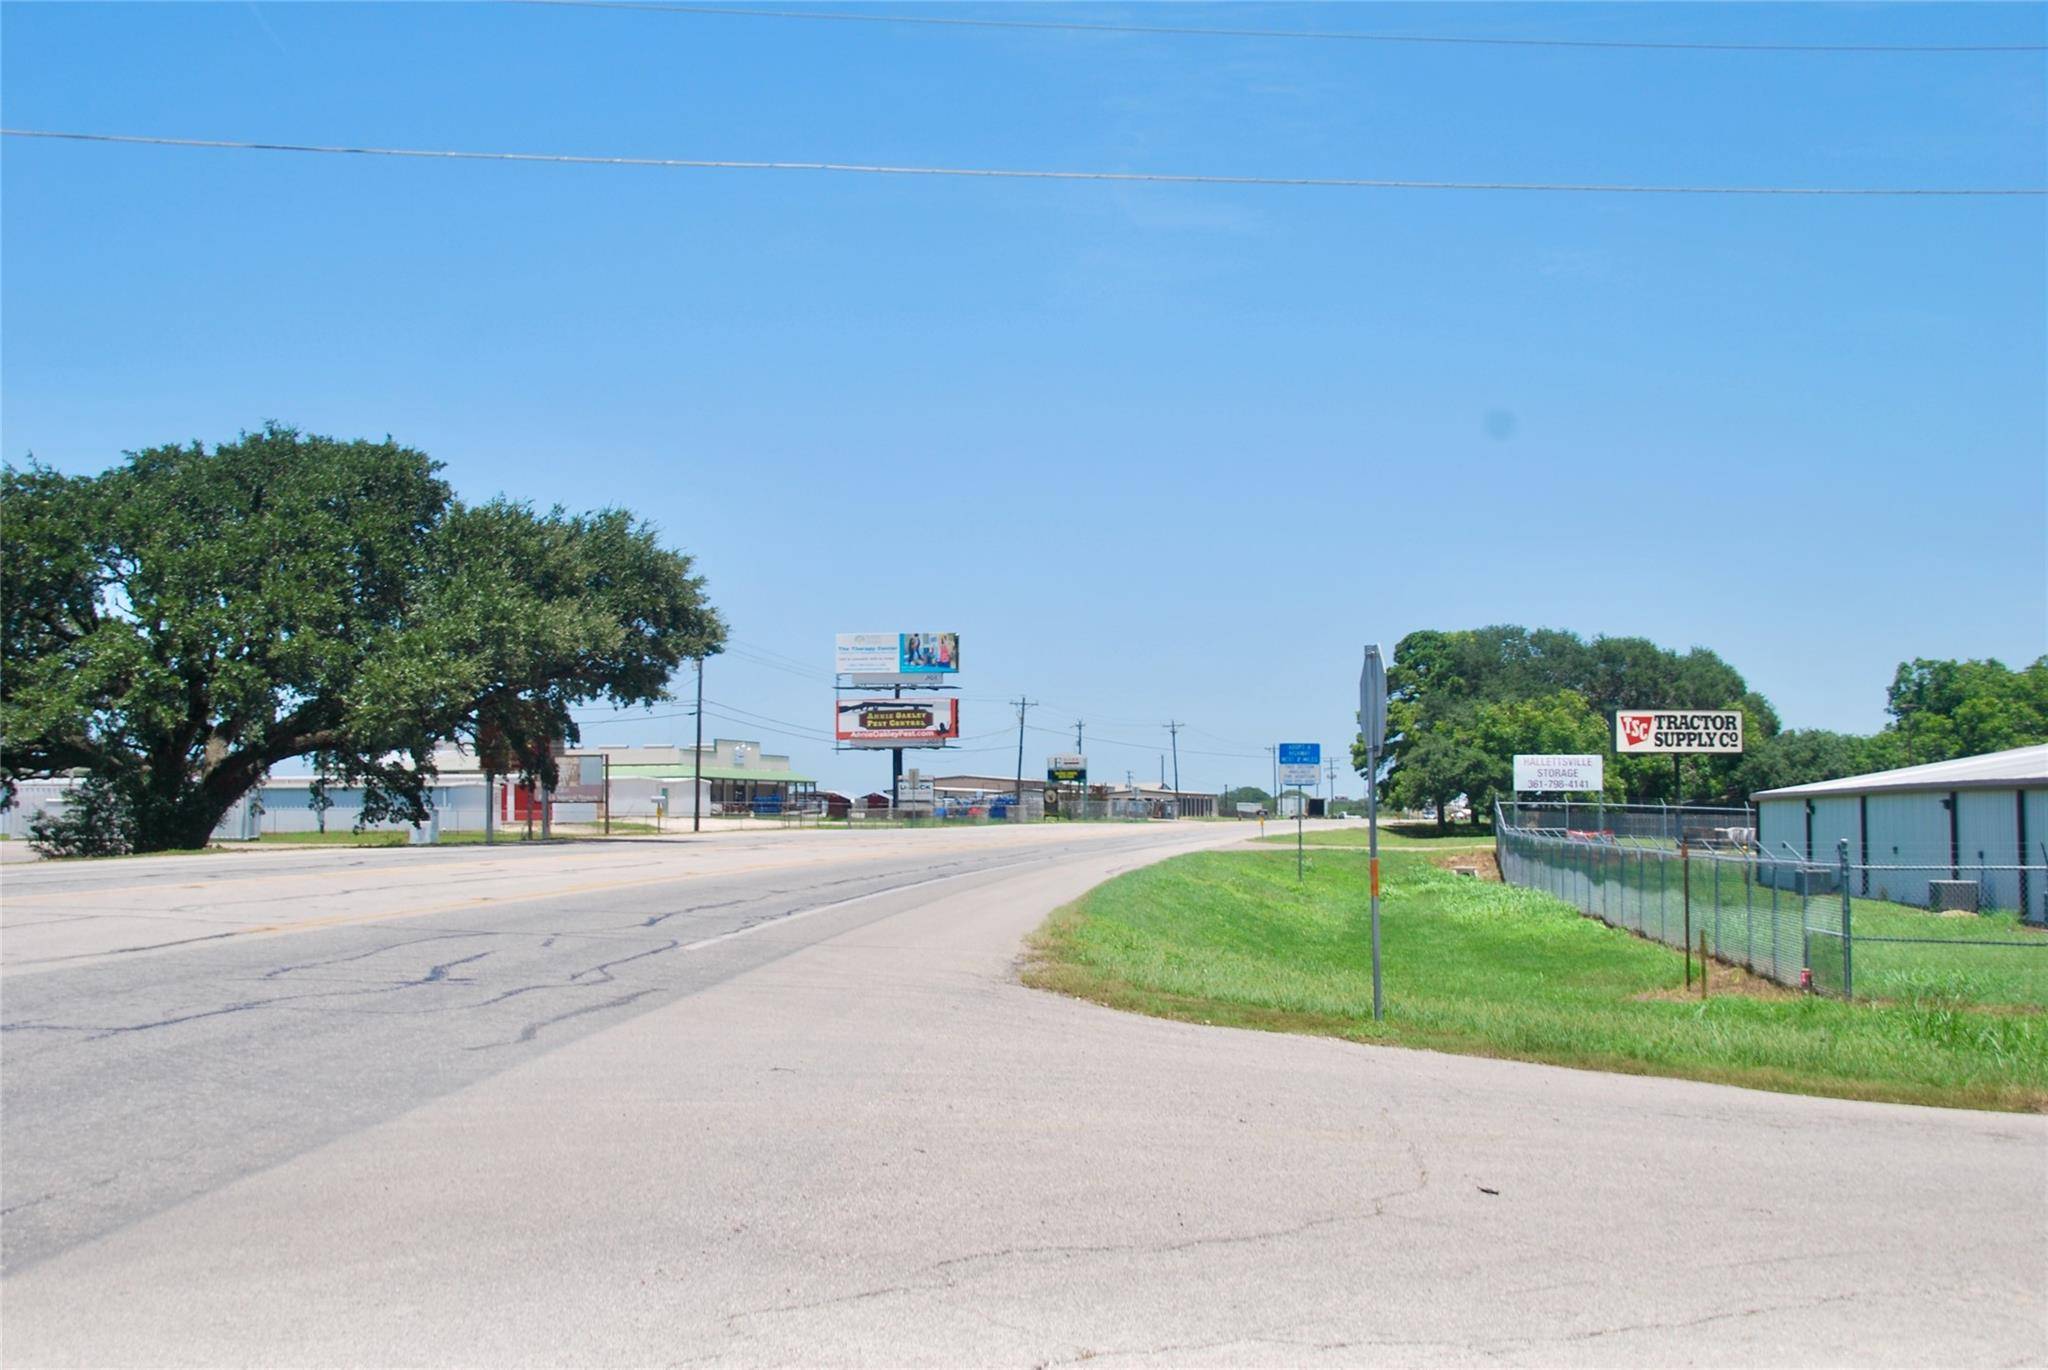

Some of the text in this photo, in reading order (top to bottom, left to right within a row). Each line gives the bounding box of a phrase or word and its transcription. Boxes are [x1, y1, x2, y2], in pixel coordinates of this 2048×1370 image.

[1623, 716, 1648, 741] TSC
[1654, 715, 1737, 730] TRACTOR
[1654, 732, 1716, 747] SUPPLY
[1523, 757, 1592, 766] HALLETTSVILLE
[1537, 768, 1579, 777] STORAGE
